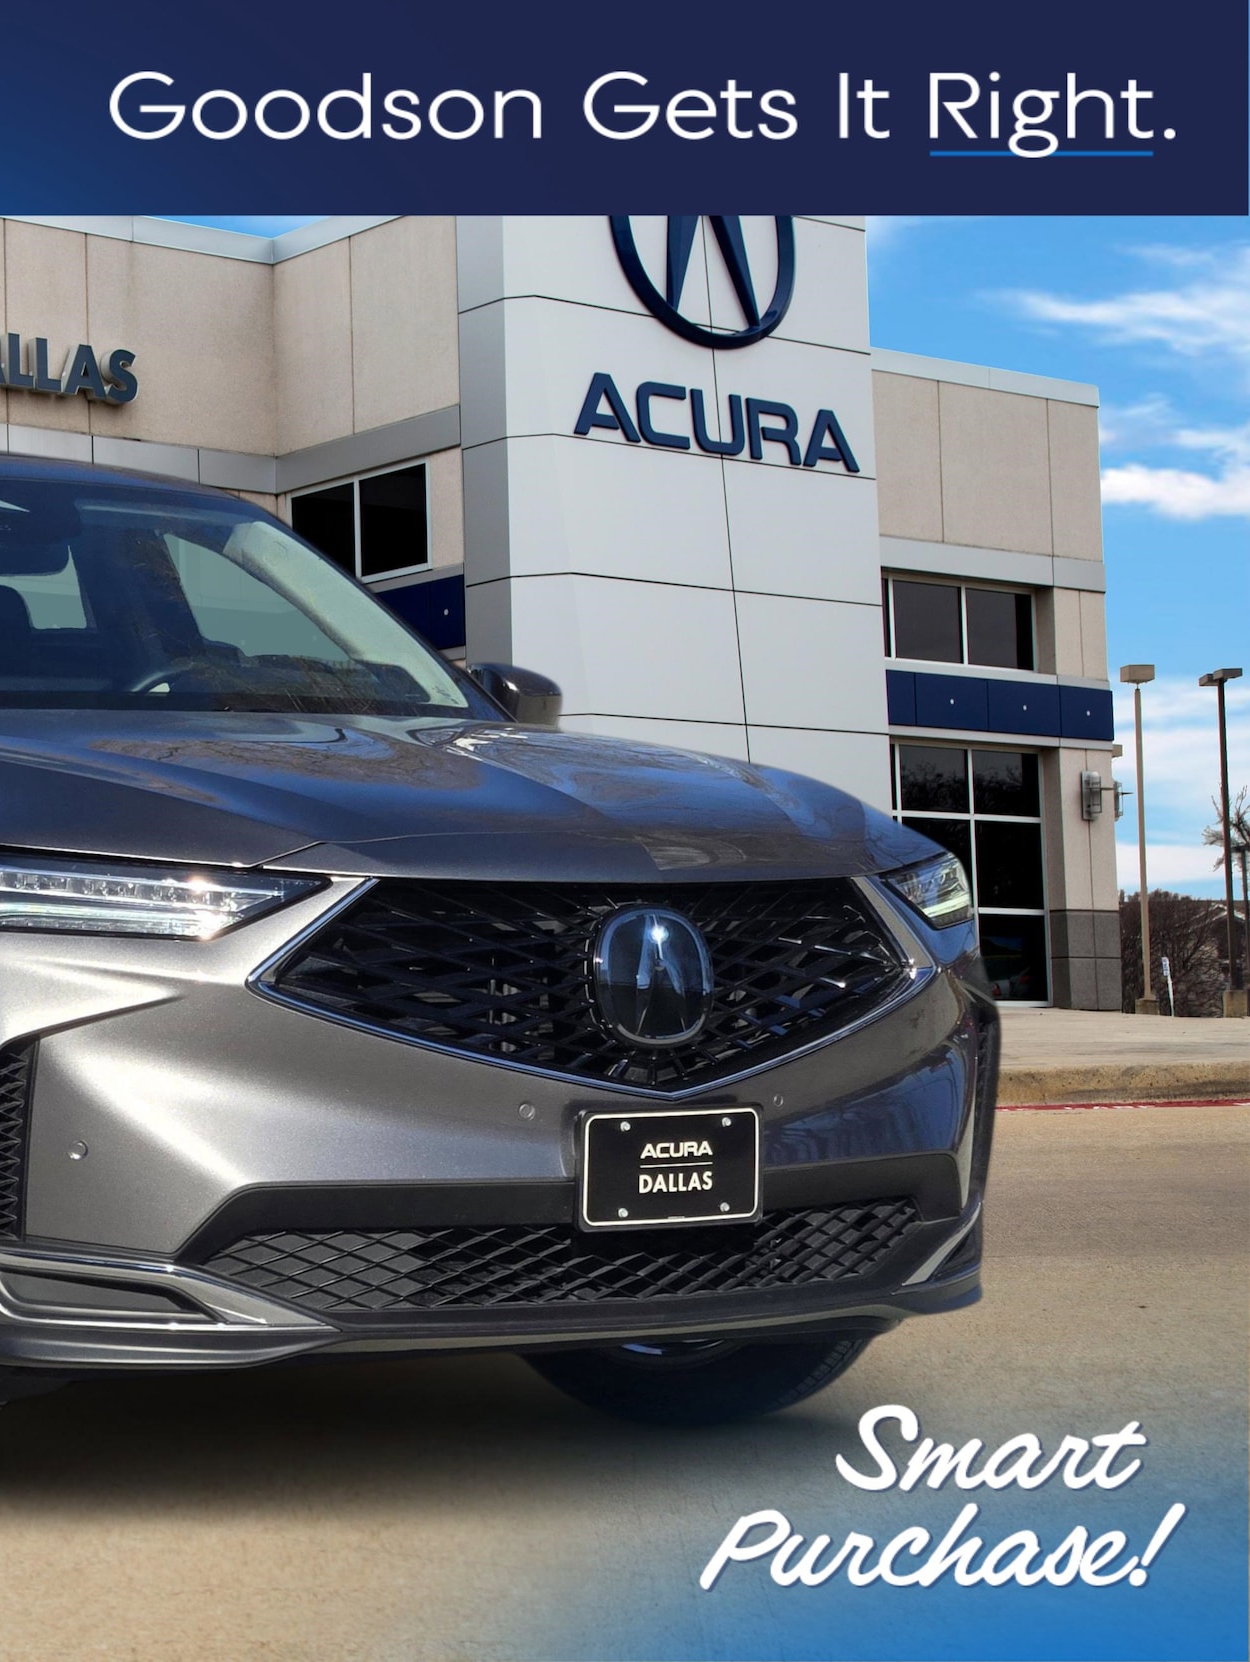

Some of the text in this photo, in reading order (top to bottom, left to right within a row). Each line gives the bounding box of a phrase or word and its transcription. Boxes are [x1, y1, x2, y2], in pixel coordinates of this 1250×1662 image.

[573, 371, 860, 473] ACURA
[640, 1140, 713, 1159] ACURA
[638, 1170, 713, 1194] DALLAS
